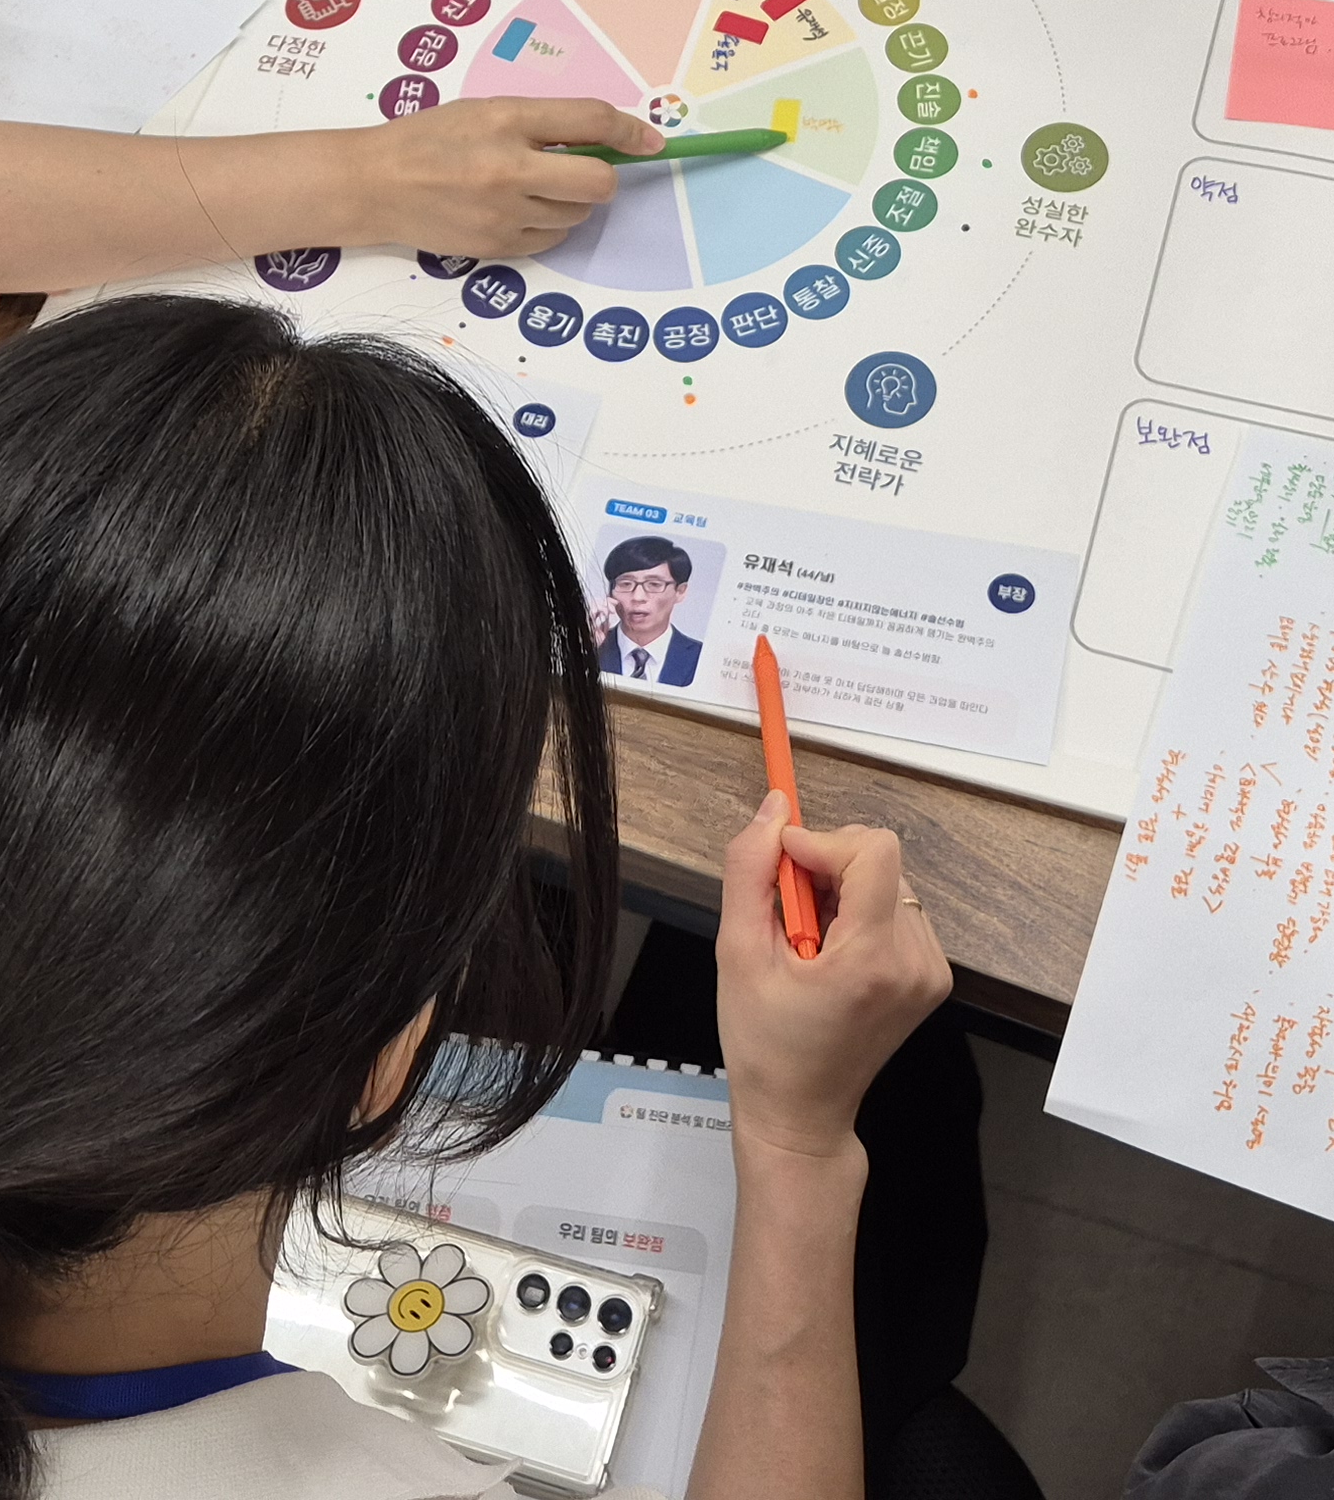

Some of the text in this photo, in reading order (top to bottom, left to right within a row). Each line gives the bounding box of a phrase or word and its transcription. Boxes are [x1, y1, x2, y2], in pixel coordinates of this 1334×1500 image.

[267, 35, 327, 58] 다정한
[410, 29, 447, 67] 공감
[898, 29, 936, 68] 끈기
[257, 55, 316, 79] 연결자
[914, 82, 942, 119] 진솔
[909, 135, 943, 173] 책임
[885, 184, 926, 226] 조절
[1190, 175, 1239, 204] 약점
[1021, 195, 1089, 224] 성실한
[1015, 218, 1083, 248] 완수자
[848, 233, 891, 274] 신중
[469, 274, 518, 312] 신념
[792, 274, 842, 311] 통찰
[525, 305, 576, 338] 용기
[591, 322, 642, 349] 촉진
[663, 323, 711, 349] 공정
[729, 304, 780, 337] 판단
[1136, 416, 1210, 455] 보완점
[829, 433, 924, 472] 지혜로운
[833, 462, 905, 496] 전략가
[614, 503, 644, 517] TEAM
[645, 508, 660, 519] 03
[743, 553, 794, 576] 유재석
[997, 584, 1028, 602] 부장
[559, 1221, 665, 1254] 우리 팀의 보완점
